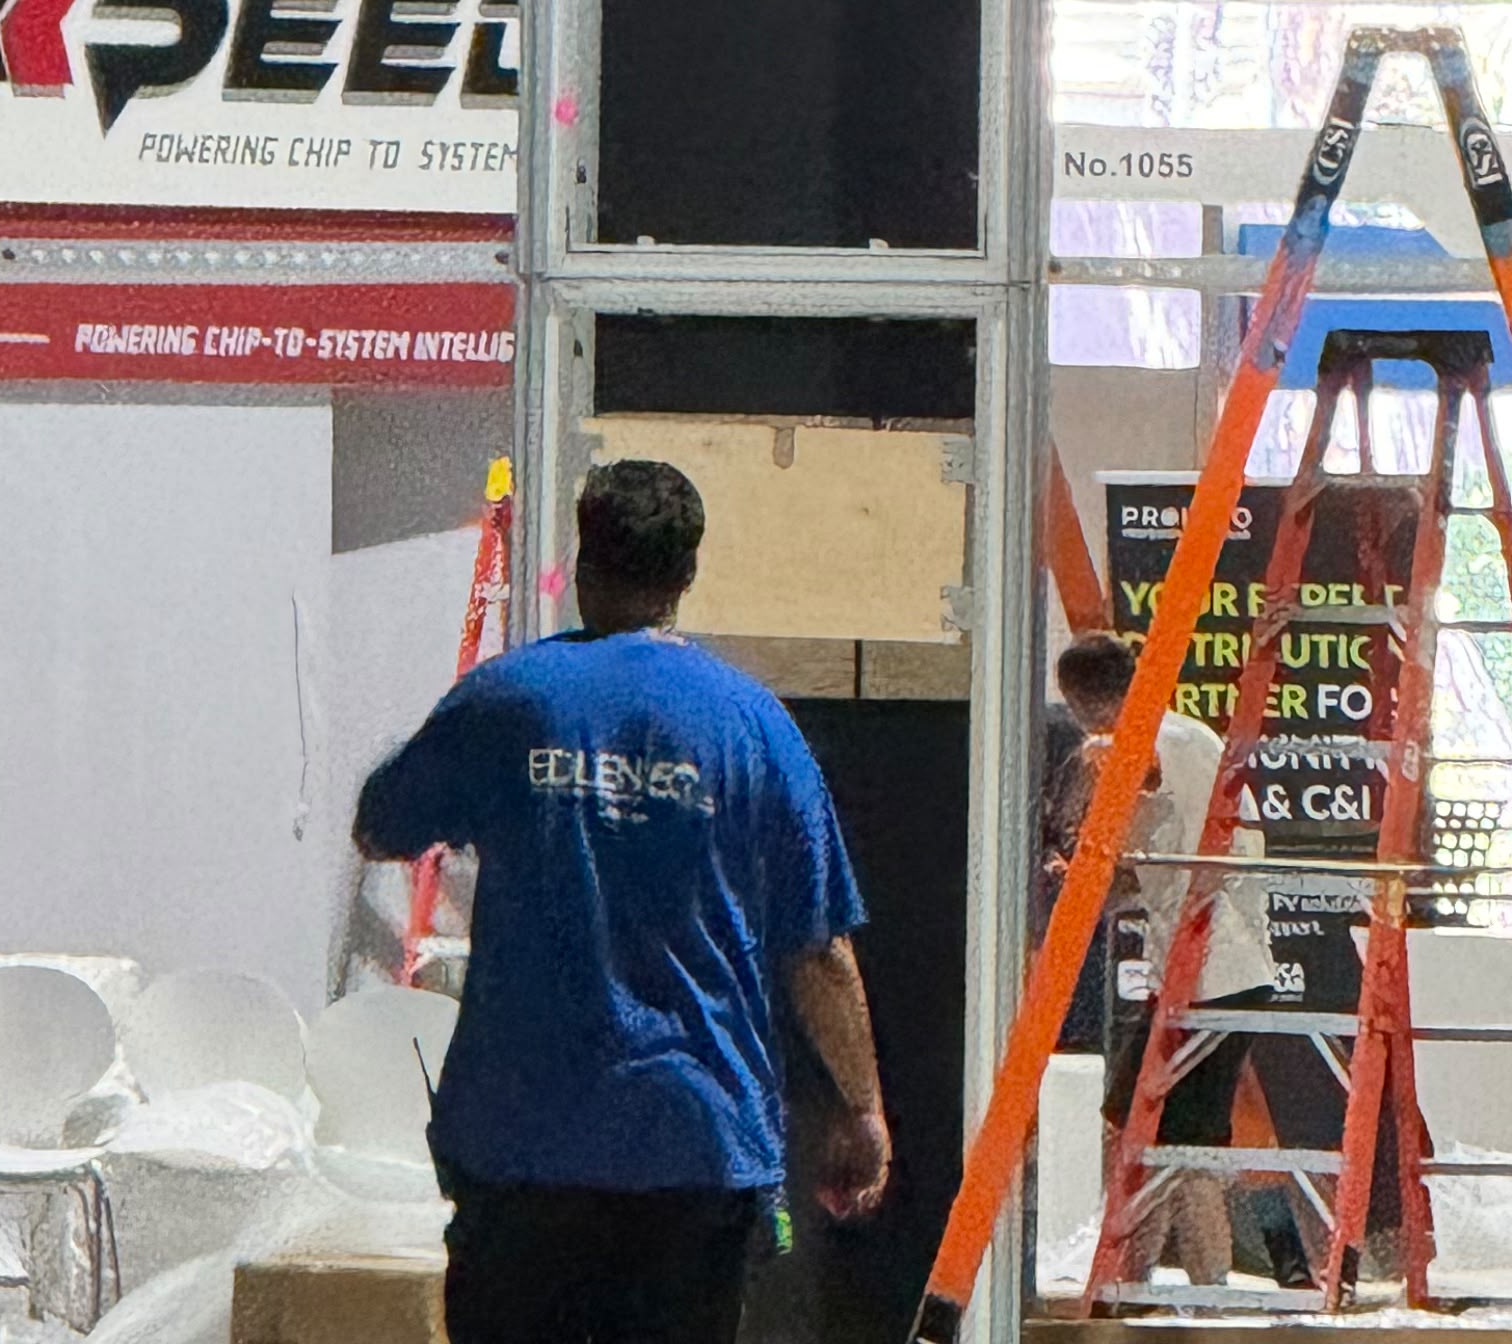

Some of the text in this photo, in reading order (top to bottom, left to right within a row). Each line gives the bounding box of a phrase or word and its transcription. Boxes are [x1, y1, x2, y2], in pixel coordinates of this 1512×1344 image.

[138, 132, 279, 166] POWERING
[287, 136, 352, 169] CHIP
[368, 139, 402, 170] TO
[1064, 151, 1194, 179] No.1055
[74, 323, 200, 355] POWERING
[204, 326, 410, 362] CHIP-TO-SYSTEM
